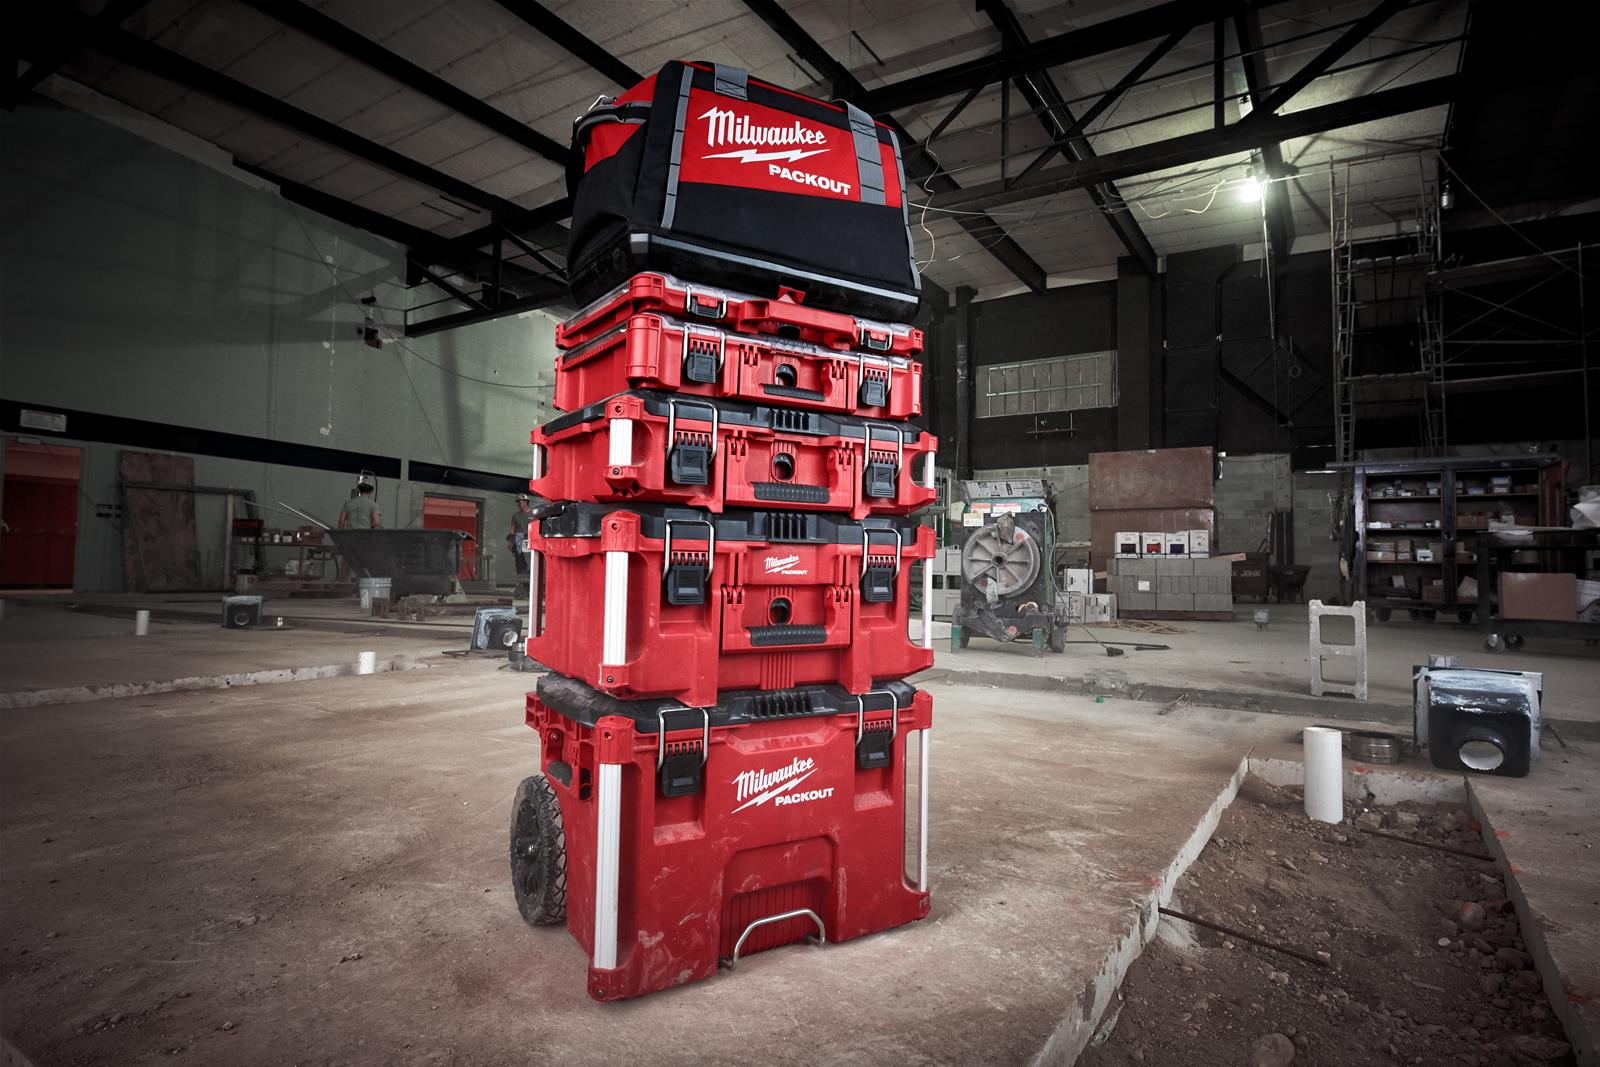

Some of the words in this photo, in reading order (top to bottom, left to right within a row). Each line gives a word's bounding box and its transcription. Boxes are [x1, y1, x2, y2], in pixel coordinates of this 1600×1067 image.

[698, 106, 827, 147] Milwaukee
[768, 164, 851, 195] PACKOUT
[764, 554, 800, 570] Milwaukee
[732, 757, 815, 801] Milwaukee
[775, 787, 834, 806] PACKOUT
